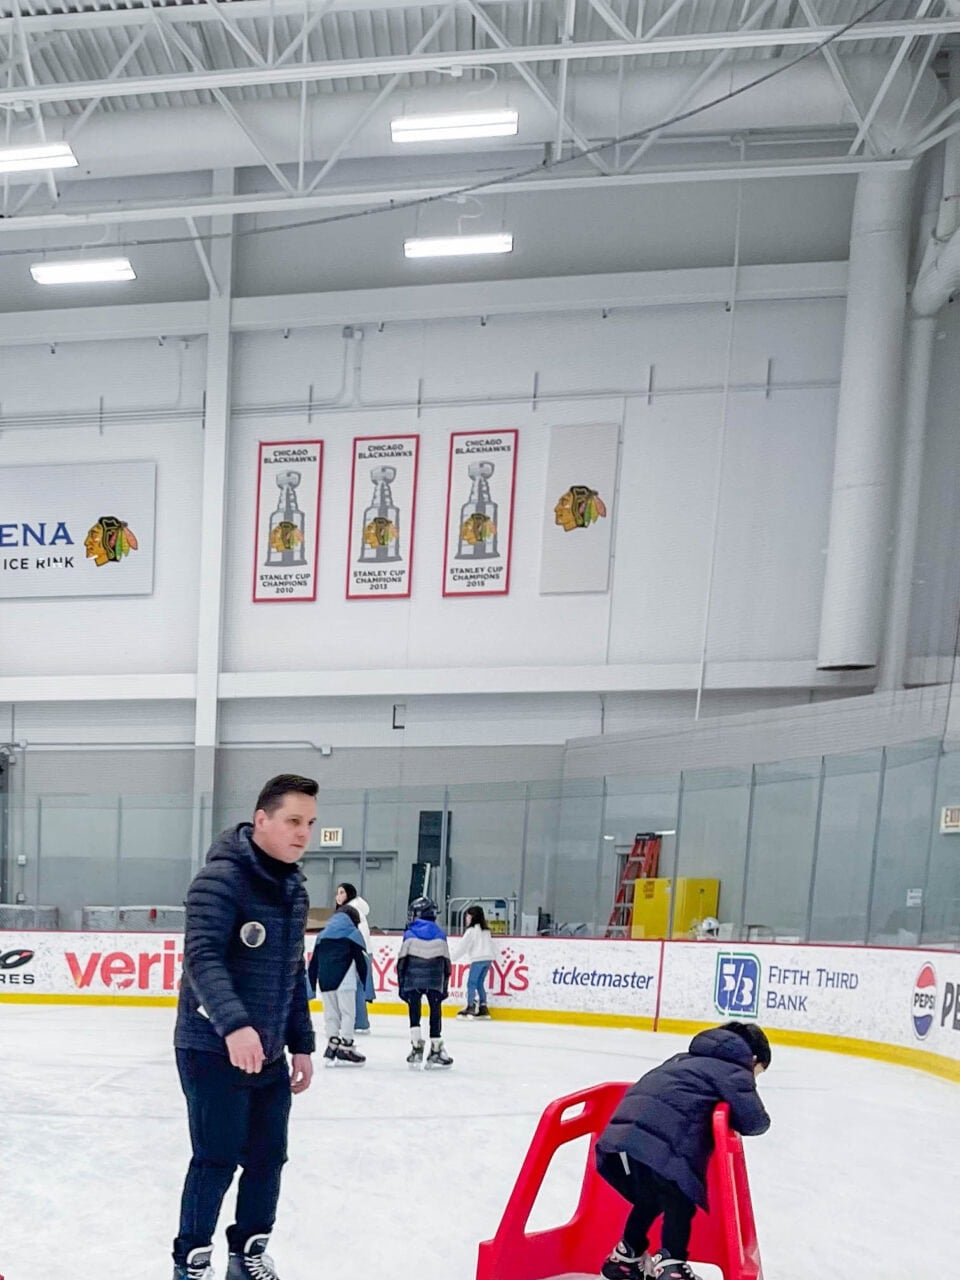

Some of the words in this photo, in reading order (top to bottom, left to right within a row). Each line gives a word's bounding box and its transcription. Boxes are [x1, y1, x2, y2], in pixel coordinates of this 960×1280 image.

[465, 438, 503, 447] CHICAGO
[367, 443, 404, 452] CHICAGO
[455, 445, 512, 454] BLACKHAWKS
[273, 449, 308, 457] CHICAGO
[358, 450, 413, 459] BLACKHAWKS
[264, 456, 317, 464] BLACKHAWKS
[4, 558, 29, 570] ICE
[450, 567, 485, 575] STANLEY
[452, 573, 500, 581] CHAMPIONS
[323, 830, 339, 842] EXIT
[65, 940, 184, 990] veri
[552, 966, 654, 989] ticketmaster
[769, 966, 810, 986] FIFTH
[816, 968, 859, 990] THIRD
[766, 991, 808, 1012] BANK
